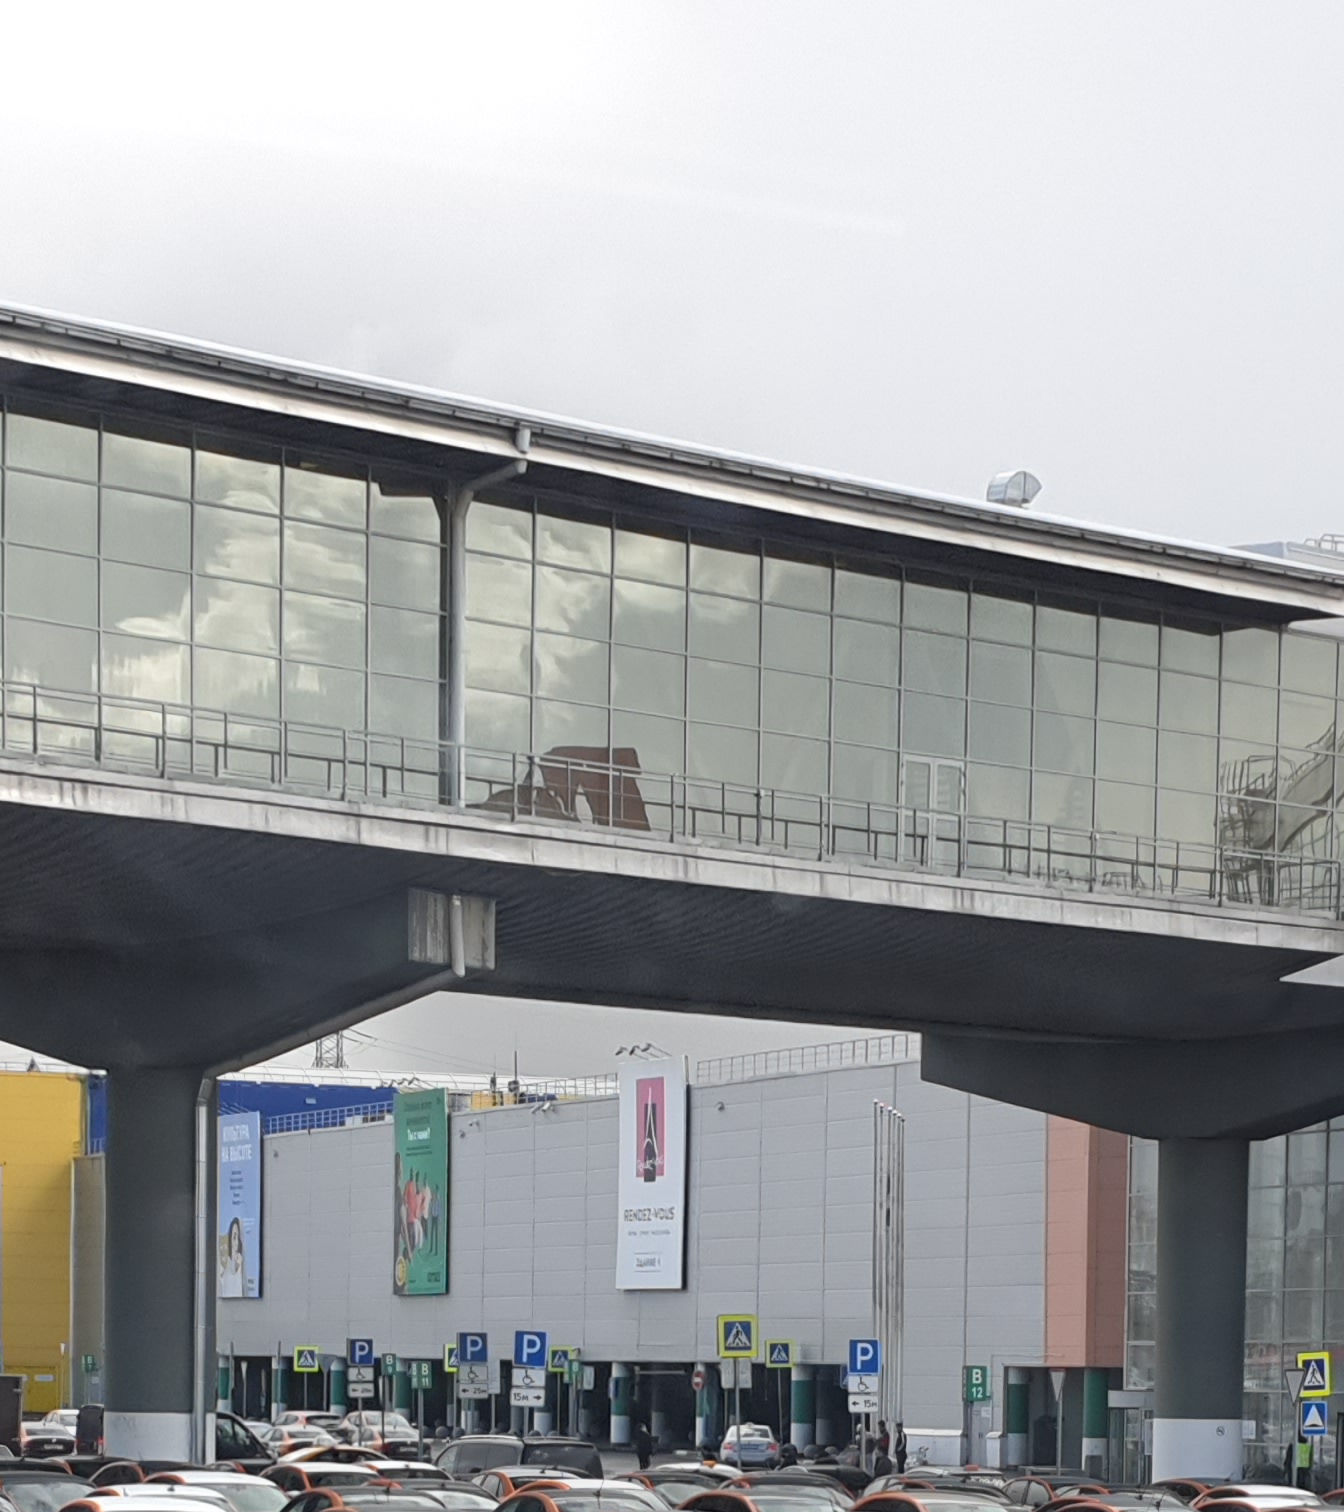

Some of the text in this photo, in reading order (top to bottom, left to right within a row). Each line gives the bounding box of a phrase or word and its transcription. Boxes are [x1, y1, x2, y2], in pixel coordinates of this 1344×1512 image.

[623, 1206, 675, 1222] RENDEZ-VOUS
[356, 1342, 369, 1363] P
[467, 1335, 482, 1360] P
[523, 1334, 542, 1363] P
[856, 1342, 874, 1370] P
[972, 1386, 984, 1399] 12
